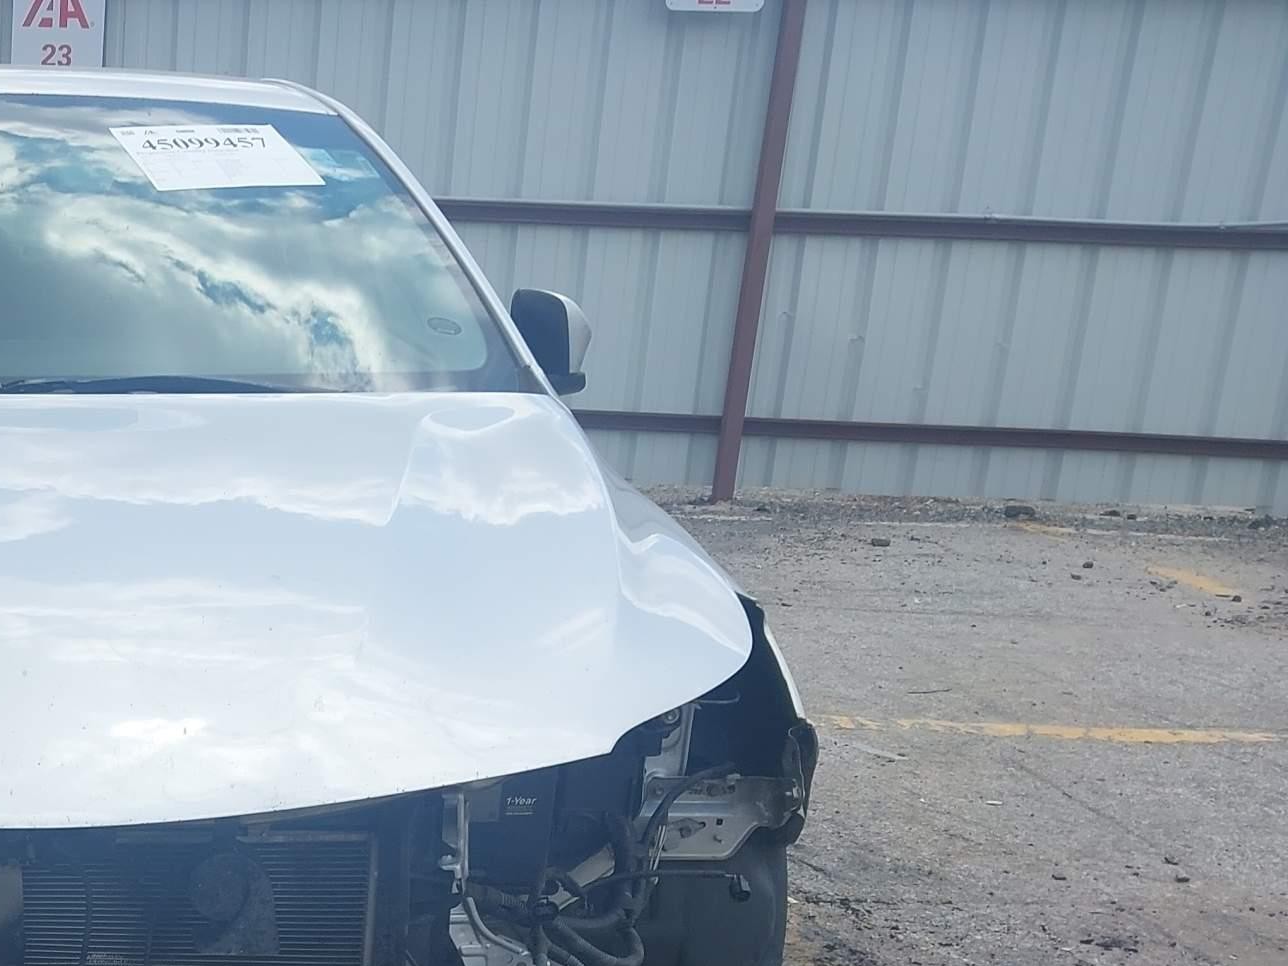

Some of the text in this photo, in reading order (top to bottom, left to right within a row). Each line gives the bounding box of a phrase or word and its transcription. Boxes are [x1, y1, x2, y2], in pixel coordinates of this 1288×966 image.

[40, 43, 72, 66] 23
[141, 136, 266, 151] 45099457
[505, 796, 537, 806] 1-Year
